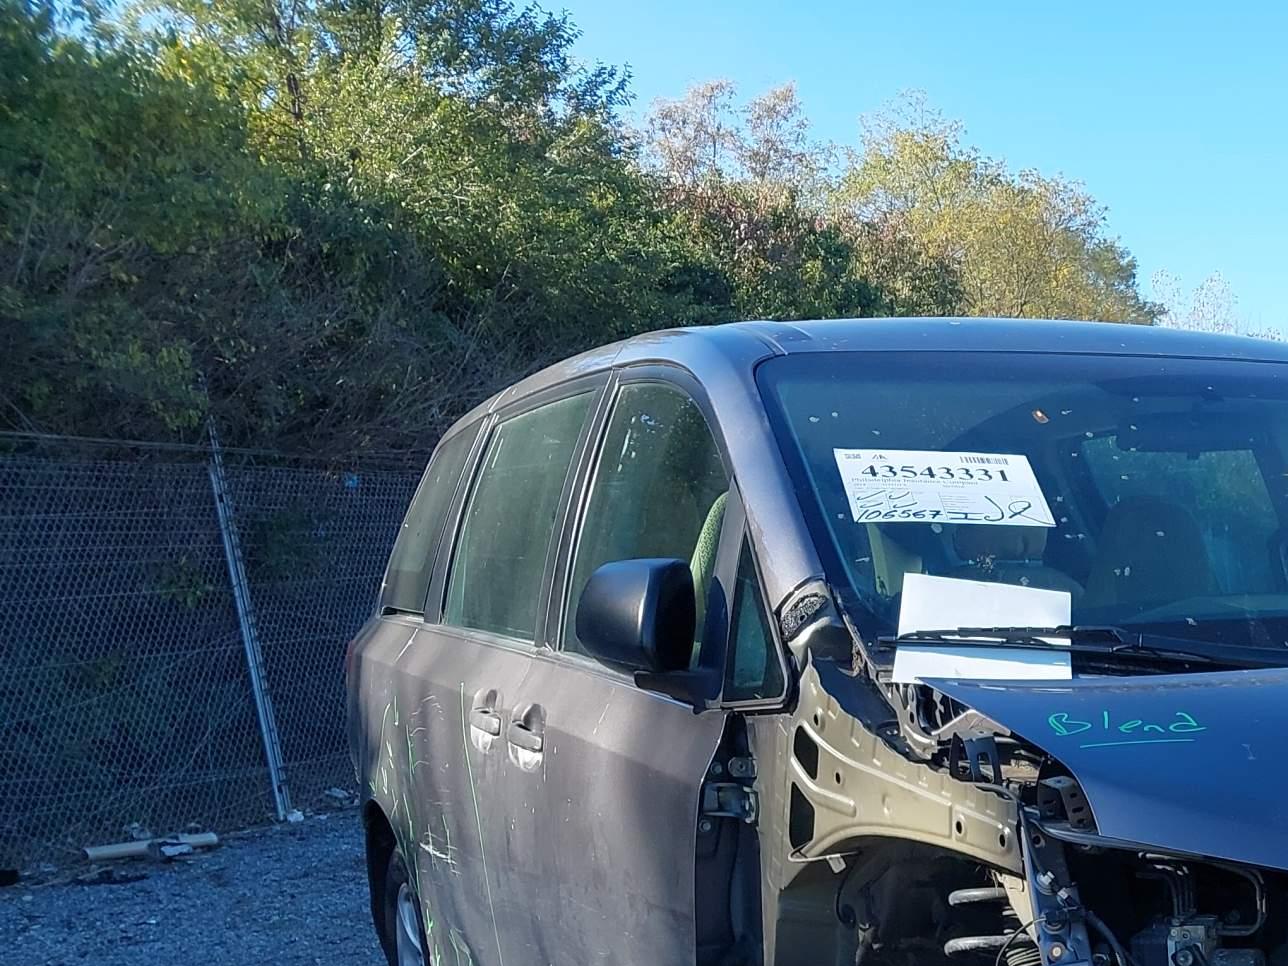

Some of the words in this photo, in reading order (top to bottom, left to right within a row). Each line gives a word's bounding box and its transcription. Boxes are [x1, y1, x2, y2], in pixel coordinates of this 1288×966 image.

[861, 465, 1012, 482] 43543331
[856, 509, 944, 523] 106567
[1047, 711, 1207, 736] Blend
